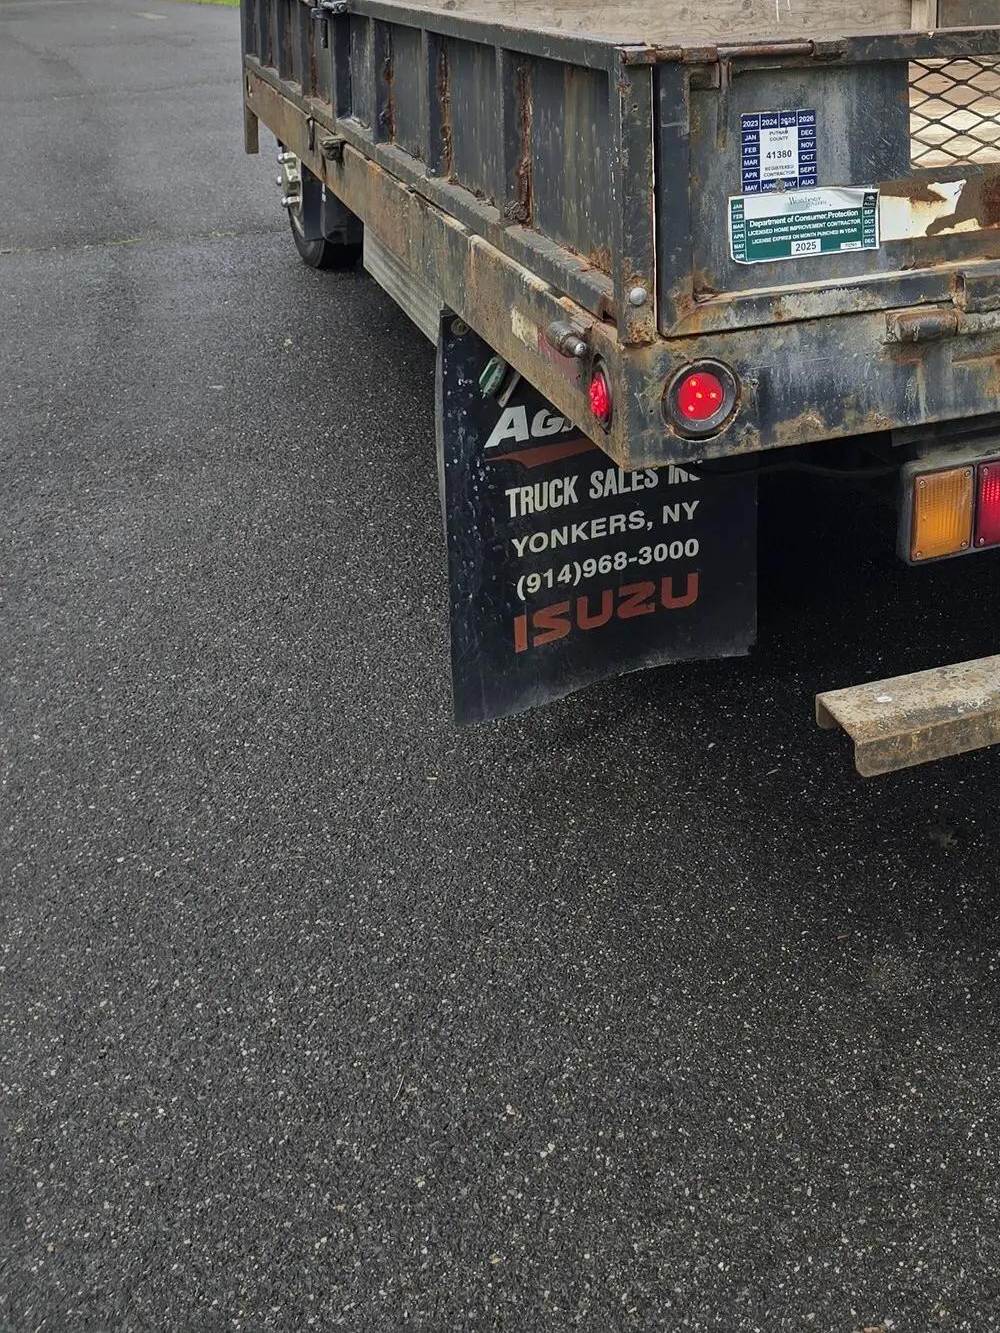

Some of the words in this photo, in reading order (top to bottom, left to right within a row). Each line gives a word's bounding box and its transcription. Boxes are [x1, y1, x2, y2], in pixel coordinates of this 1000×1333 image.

[762, 118, 778, 126] 2024
[766, 150, 792, 159] 41380
[748, 228, 773, 236] LICENSED
[790, 222, 826, 231] IMPROVEMENT
[826, 219, 861, 227] CONTRACTOR
[750, 217, 786, 228] Department
[828, 210, 859, 218] Protection
[795, 242, 817, 251] 2025
[505, 475, 579, 518] TRUCK
[589, 468, 659, 500] SALES
[511, 510, 653, 558] YONKERS,
[662, 500, 700, 524] NY
[516, 538, 699, 601] (914)968-3000
[513, 572, 699, 654] ISUZU
